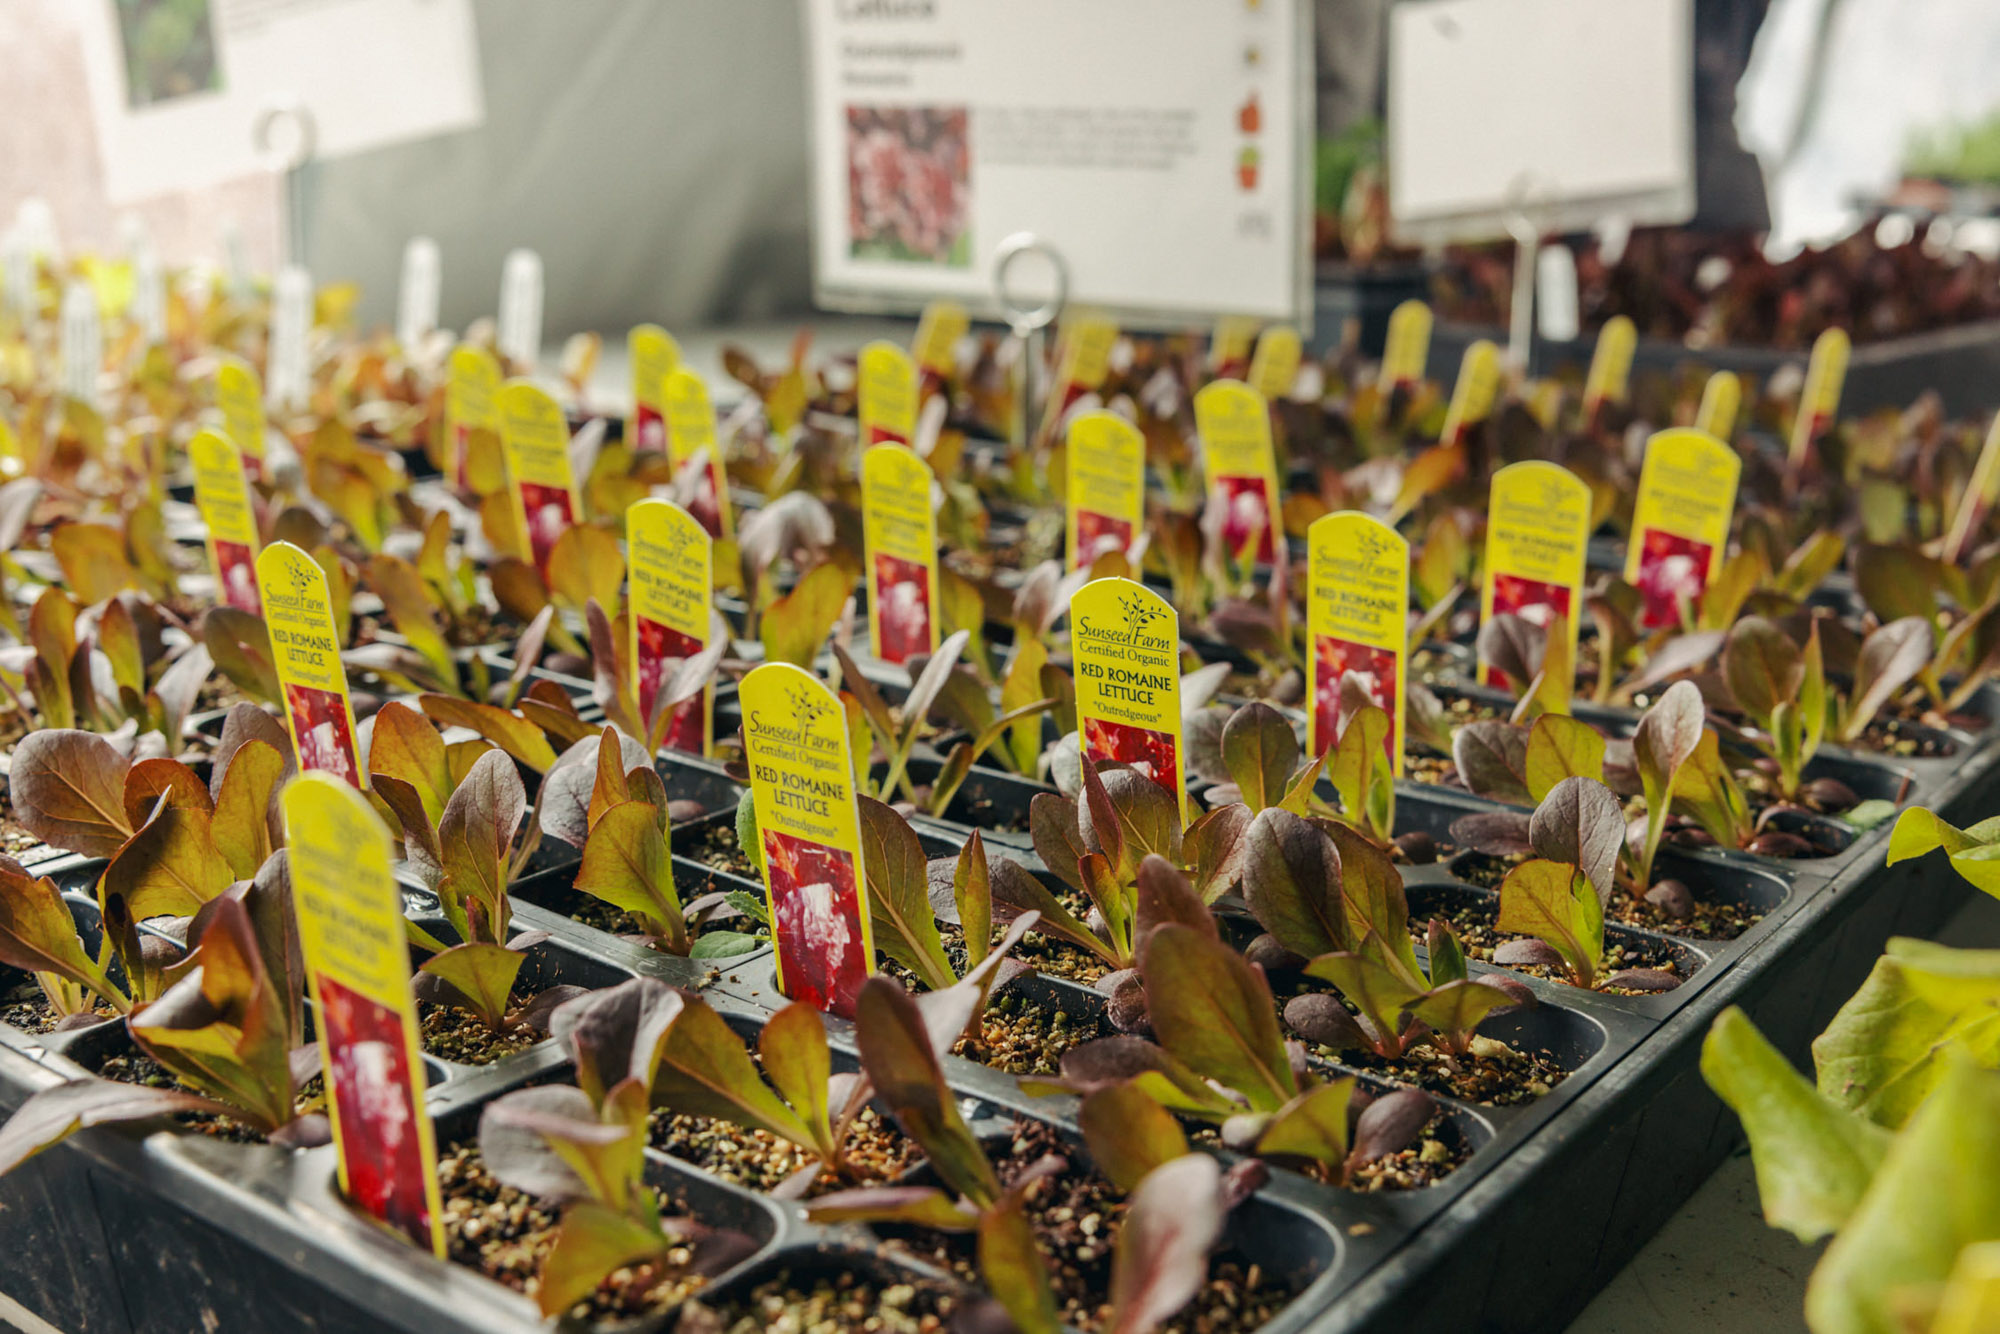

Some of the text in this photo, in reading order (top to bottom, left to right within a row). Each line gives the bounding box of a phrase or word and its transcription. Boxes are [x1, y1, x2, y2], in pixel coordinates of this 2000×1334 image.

[290, 632, 333, 651] ROMAINE
[1133, 626, 1170, 650] Farm
[287, 647, 325, 667] LETTUCE
[1080, 640, 1169, 667] Certified Organic
[1081, 662, 1172, 691] RED ROMAINE
[1098, 682, 1154, 705] LETTUCE
[1093, 701, 1162, 723] "Outredgeous"
[803, 724, 839, 750] Farm
[752, 738, 841, 773] Certified Organic
[755, 764, 846, 801] RED ROMAINE
[774, 788, 830, 817] LETTUCE
